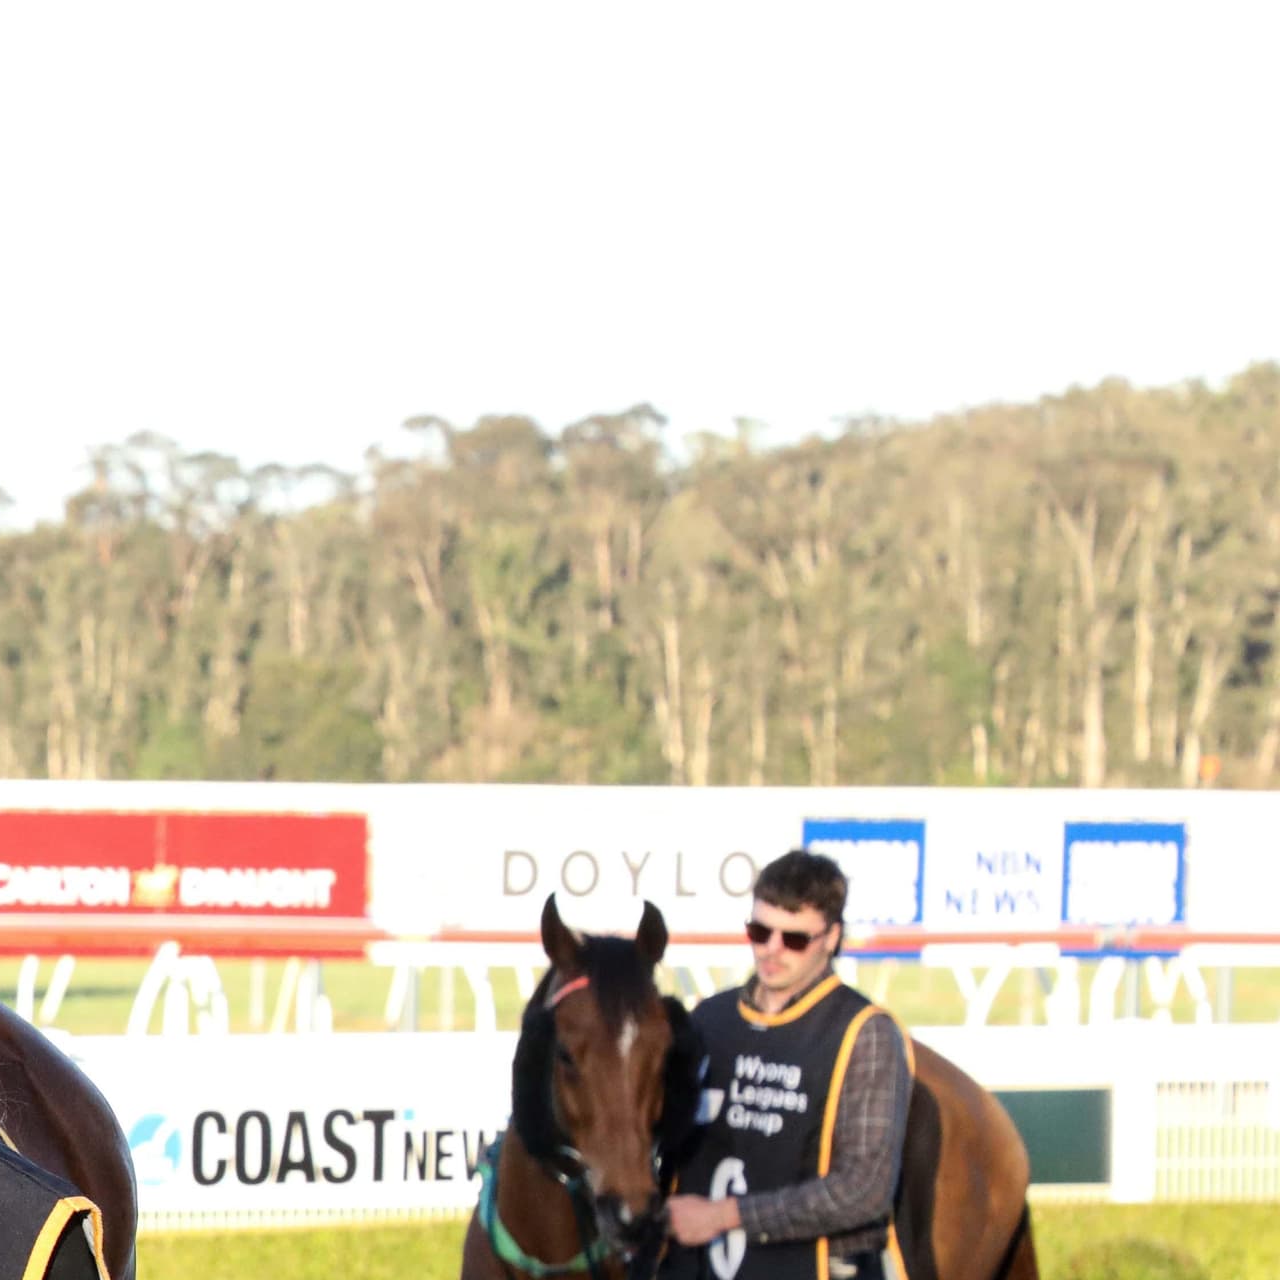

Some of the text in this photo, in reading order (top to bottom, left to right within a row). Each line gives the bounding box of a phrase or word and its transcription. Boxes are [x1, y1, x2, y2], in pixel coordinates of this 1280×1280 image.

[735, 1054, 802, 1090] Wyong
[730, 1078, 808, 1114] Leagues
[192, 1109, 396, 1185] COAST
